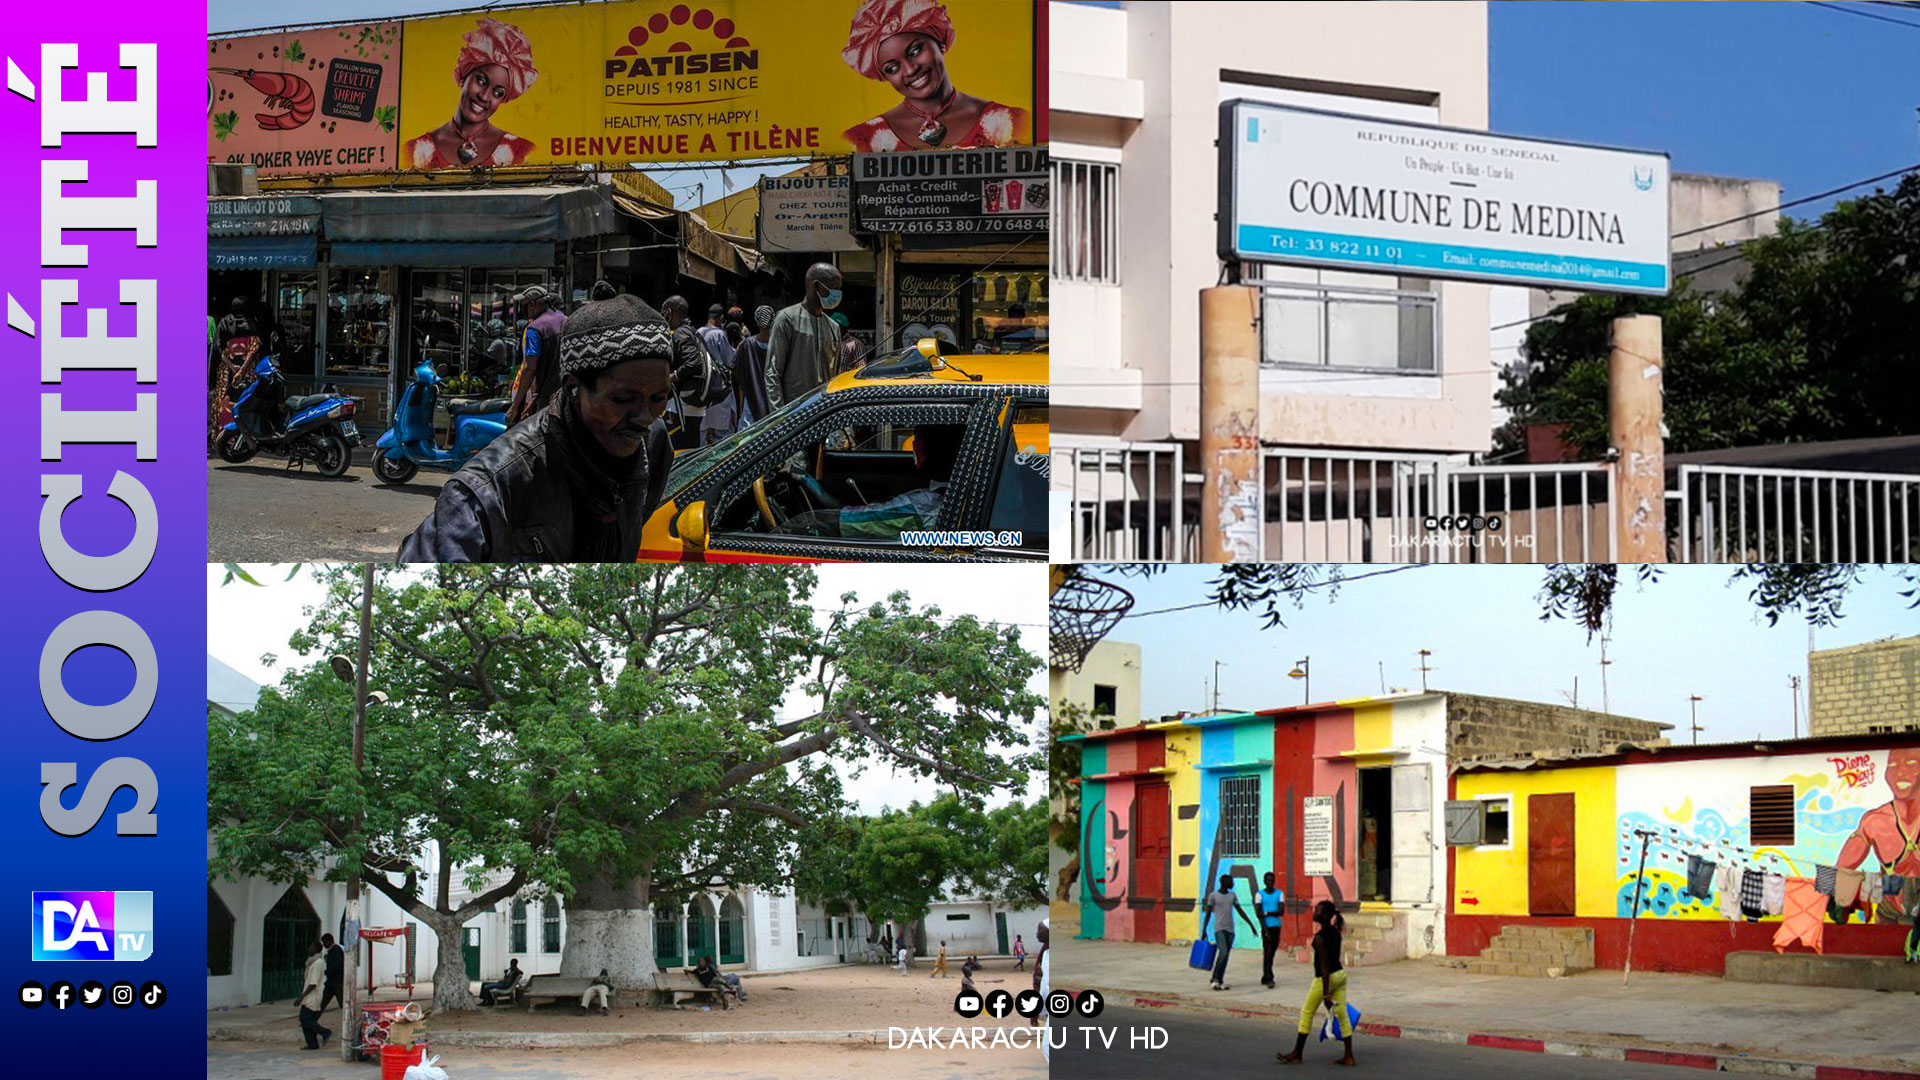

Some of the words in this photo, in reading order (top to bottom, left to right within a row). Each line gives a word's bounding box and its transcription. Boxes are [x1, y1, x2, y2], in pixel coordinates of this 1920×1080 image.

[605, 50, 758, 79] PATISEN
[333, 70, 377, 89] CREVETTE
[605, 83, 660, 97] DEPUIS
[667, 80, 701, 94] 1981
[709, 76, 758, 91] SINCE
[333, 87, 366, 105] SHRIMP
[604, 115, 661, 129] HEALTHY,
[664, 113, 704, 127] TASTY,
[707, 111, 751, 125] HAPPY
[755, 110, 759, 122] !
[551, 134, 689, 156] BIENVENUE
[699, 133, 717, 153] A
[727, 123, 819, 150] TILÈNE
[1464, 143, 1487, 154] DU
[296, 150, 332, 166] YAYE
[337, 147, 374, 165] CHEF
[380, 146, 385, 163] !
[863, 151, 1007, 178] BIJOUTERIE
[765, 177, 849, 190] BIJOUTER
[877, 183, 912, 193] Achat
[920, 181, 958, 192] Credit
[779, 202, 808, 210] CHEZ
[813, 201, 849, 209] TOURE
[860, 194, 904, 206] Reprise
[884, 205, 950, 216] Réparation
[1289, 178, 1451, 228] COMMUNE
[1462, 197, 1501, 233] DE
[1511, 202, 1626, 245] MEDINA
[889, 222, 903, 233] 77
[908, 221, 933, 232] 616
[936, 221, 953, 231] 53
[956, 220, 973, 231] 80
[985, 220, 1002, 231] 70
[1005, 219, 1033, 230] 648
[1269, 234, 1299, 249] Tel:
[1305, 239, 1324, 251] 33
[1329, 241, 1359, 255] 822
[1385, 247, 1402, 259] 01
[1443, 251, 1476, 265] Email:
[902, 297, 929, 311] DAROU
[903, 314, 927, 322] Mass
[1826, 754, 1871, 773] Diene
